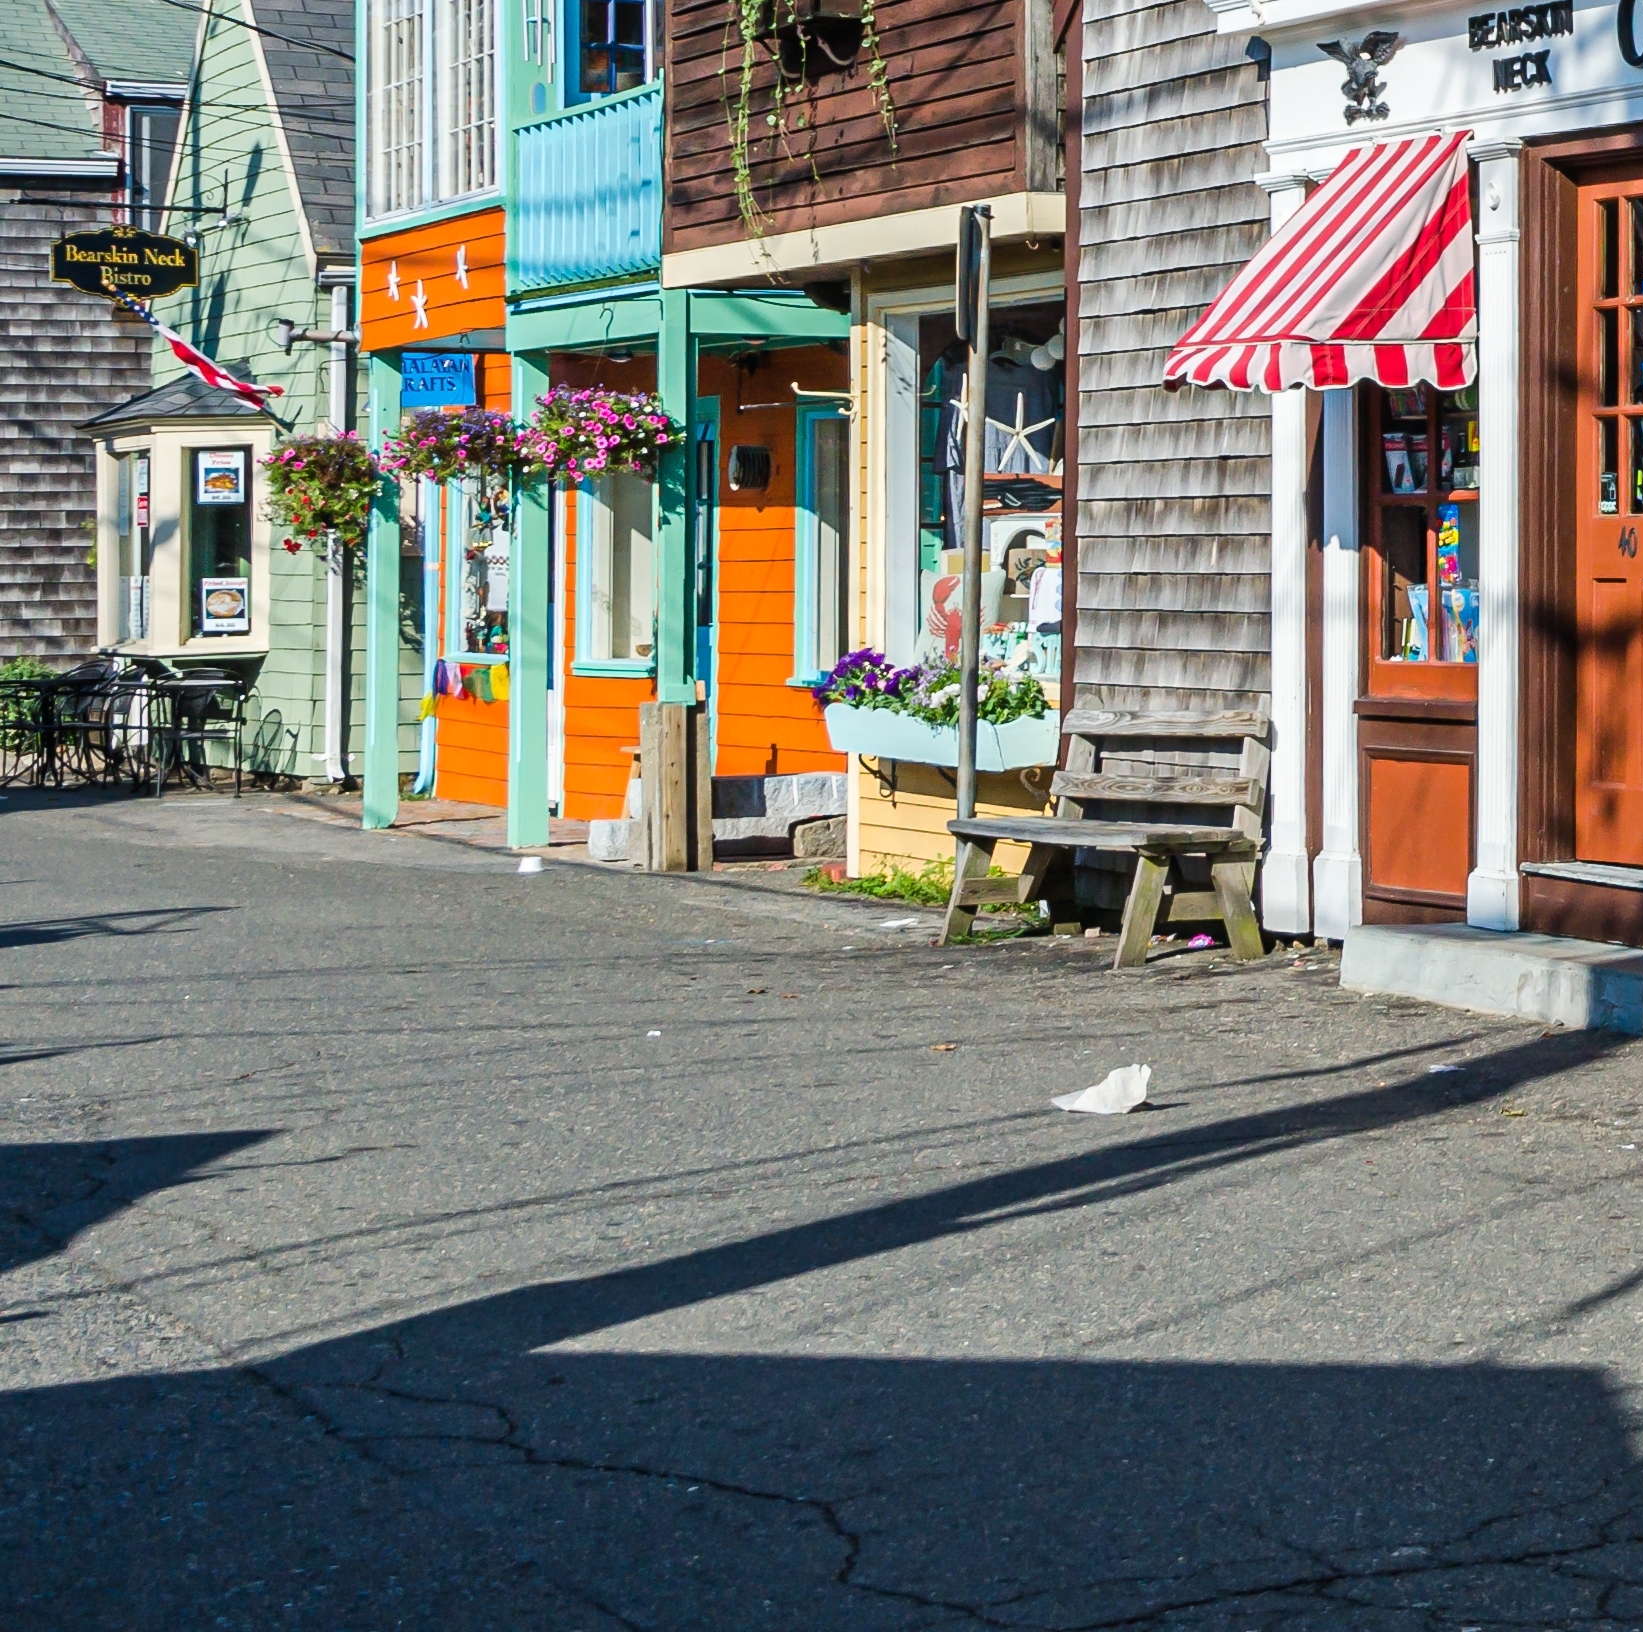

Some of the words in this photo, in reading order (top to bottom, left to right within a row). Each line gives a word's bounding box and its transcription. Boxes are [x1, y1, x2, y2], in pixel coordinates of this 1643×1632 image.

[1492, 49, 1552, 94] NECK
[65, 244, 138, 263] Bearskin
[143, 248, 185, 266] Neck
[100, 266, 151, 285] Bistro
[402, 358, 470, 374] ALAYAN
[404, 376, 457, 392] RAFTS
[1617, 524, 1638, 559] 40
